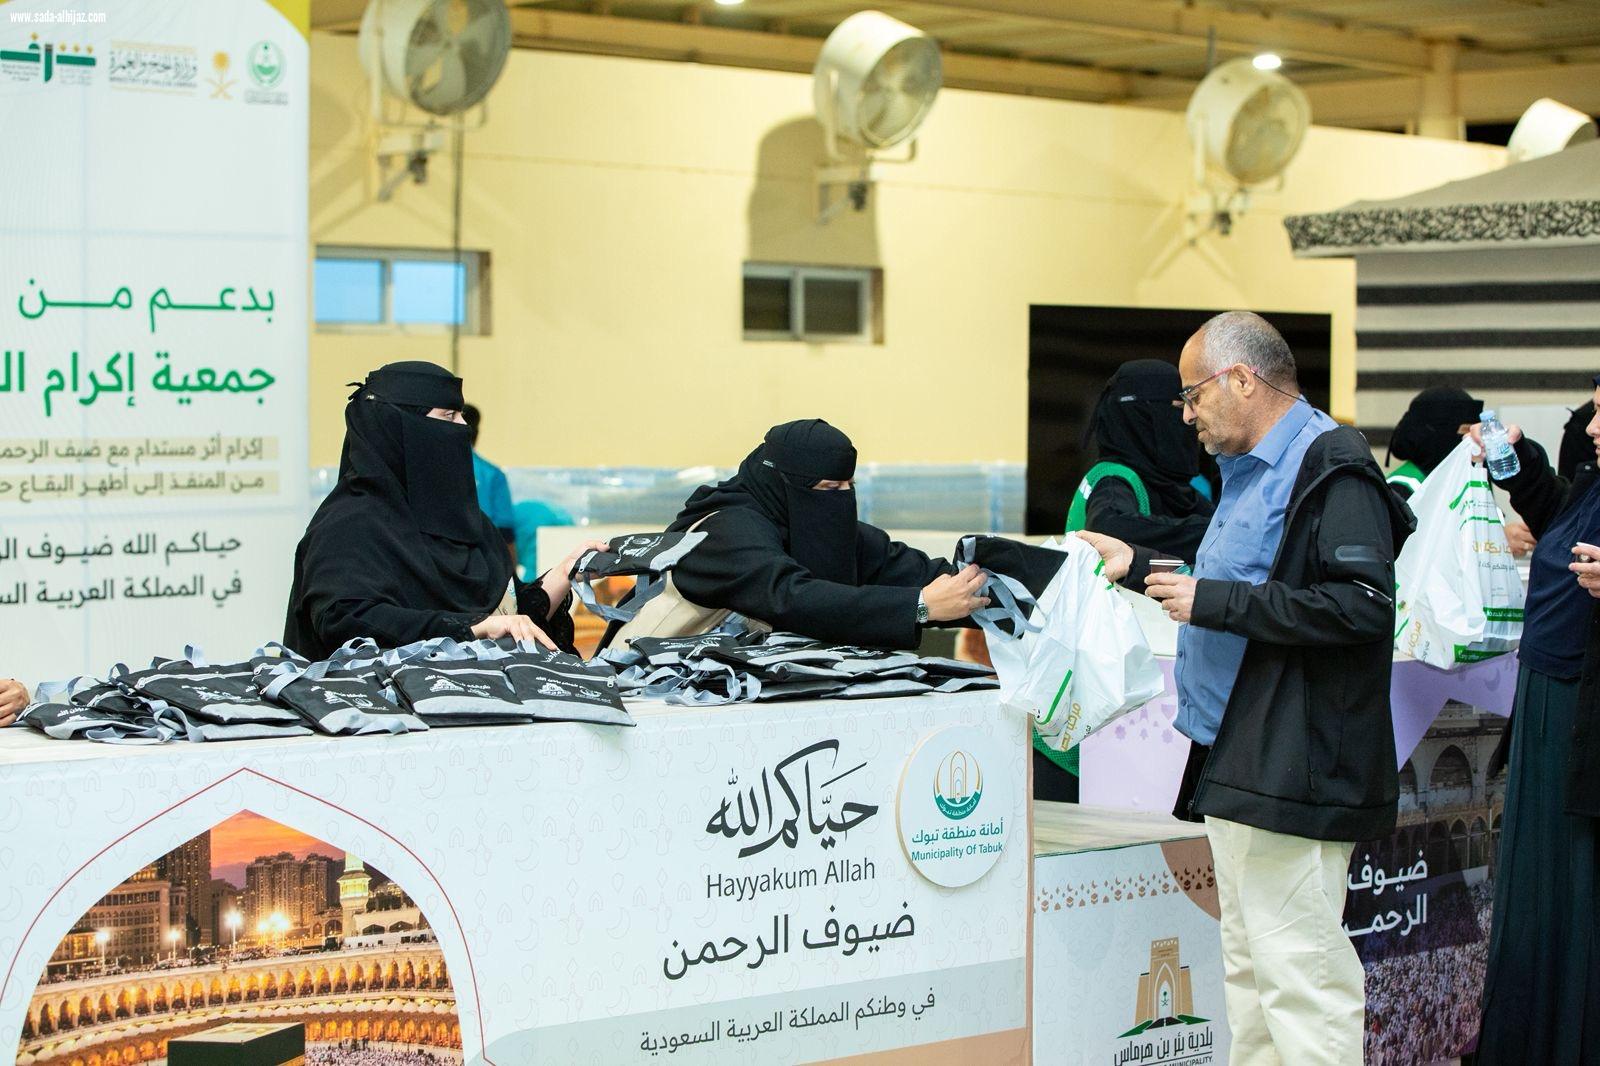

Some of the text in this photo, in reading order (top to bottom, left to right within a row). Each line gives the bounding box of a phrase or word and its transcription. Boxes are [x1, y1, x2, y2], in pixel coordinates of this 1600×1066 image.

[19, 278, 274, 333] بدعم من
[44, 351, 135, 417] إكرام
[152, 351, 275, 405] جمعية
[0, 432, 263, 467] إكرام أثر مستدام مع ضيف الرحم
[19, 475, 73, 502] البقاع
[78, 467, 129, 498] أطهر
[134, 472, 163, 496] إلى
[170, 470, 225, 491] المنفذ
[230, 473, 264, 493] من
[27, 533, 113, 564] ضيوف
[122, 533, 156, 556] الله
[165, 531, 242, 566] حياكم
[37, 579, 114, 609] العربية
[124, 575, 204, 599] المملكة
[212, 570, 242, 607] في
[911, 817, 1003, 845] أمانة منطقة تبوك
[911, 842, 1003, 861] Municipality Of Tabuk
[707, 857, 875, 902] Hayyakum Allah
[1347, 849, 1428, 895] ضيوف
[1343, 893, 1427, 937] الرحم
[662, 900, 915, 981] ضيوف الرحمن
[639, 987, 936, 1057] في وطنكم المملكة العربية السعودية
[1157, 1037, 1170, 1059] بن
[1174, 1031, 1185, 1056] بئر
[1188, 1026, 1213, 1052] بلدية
